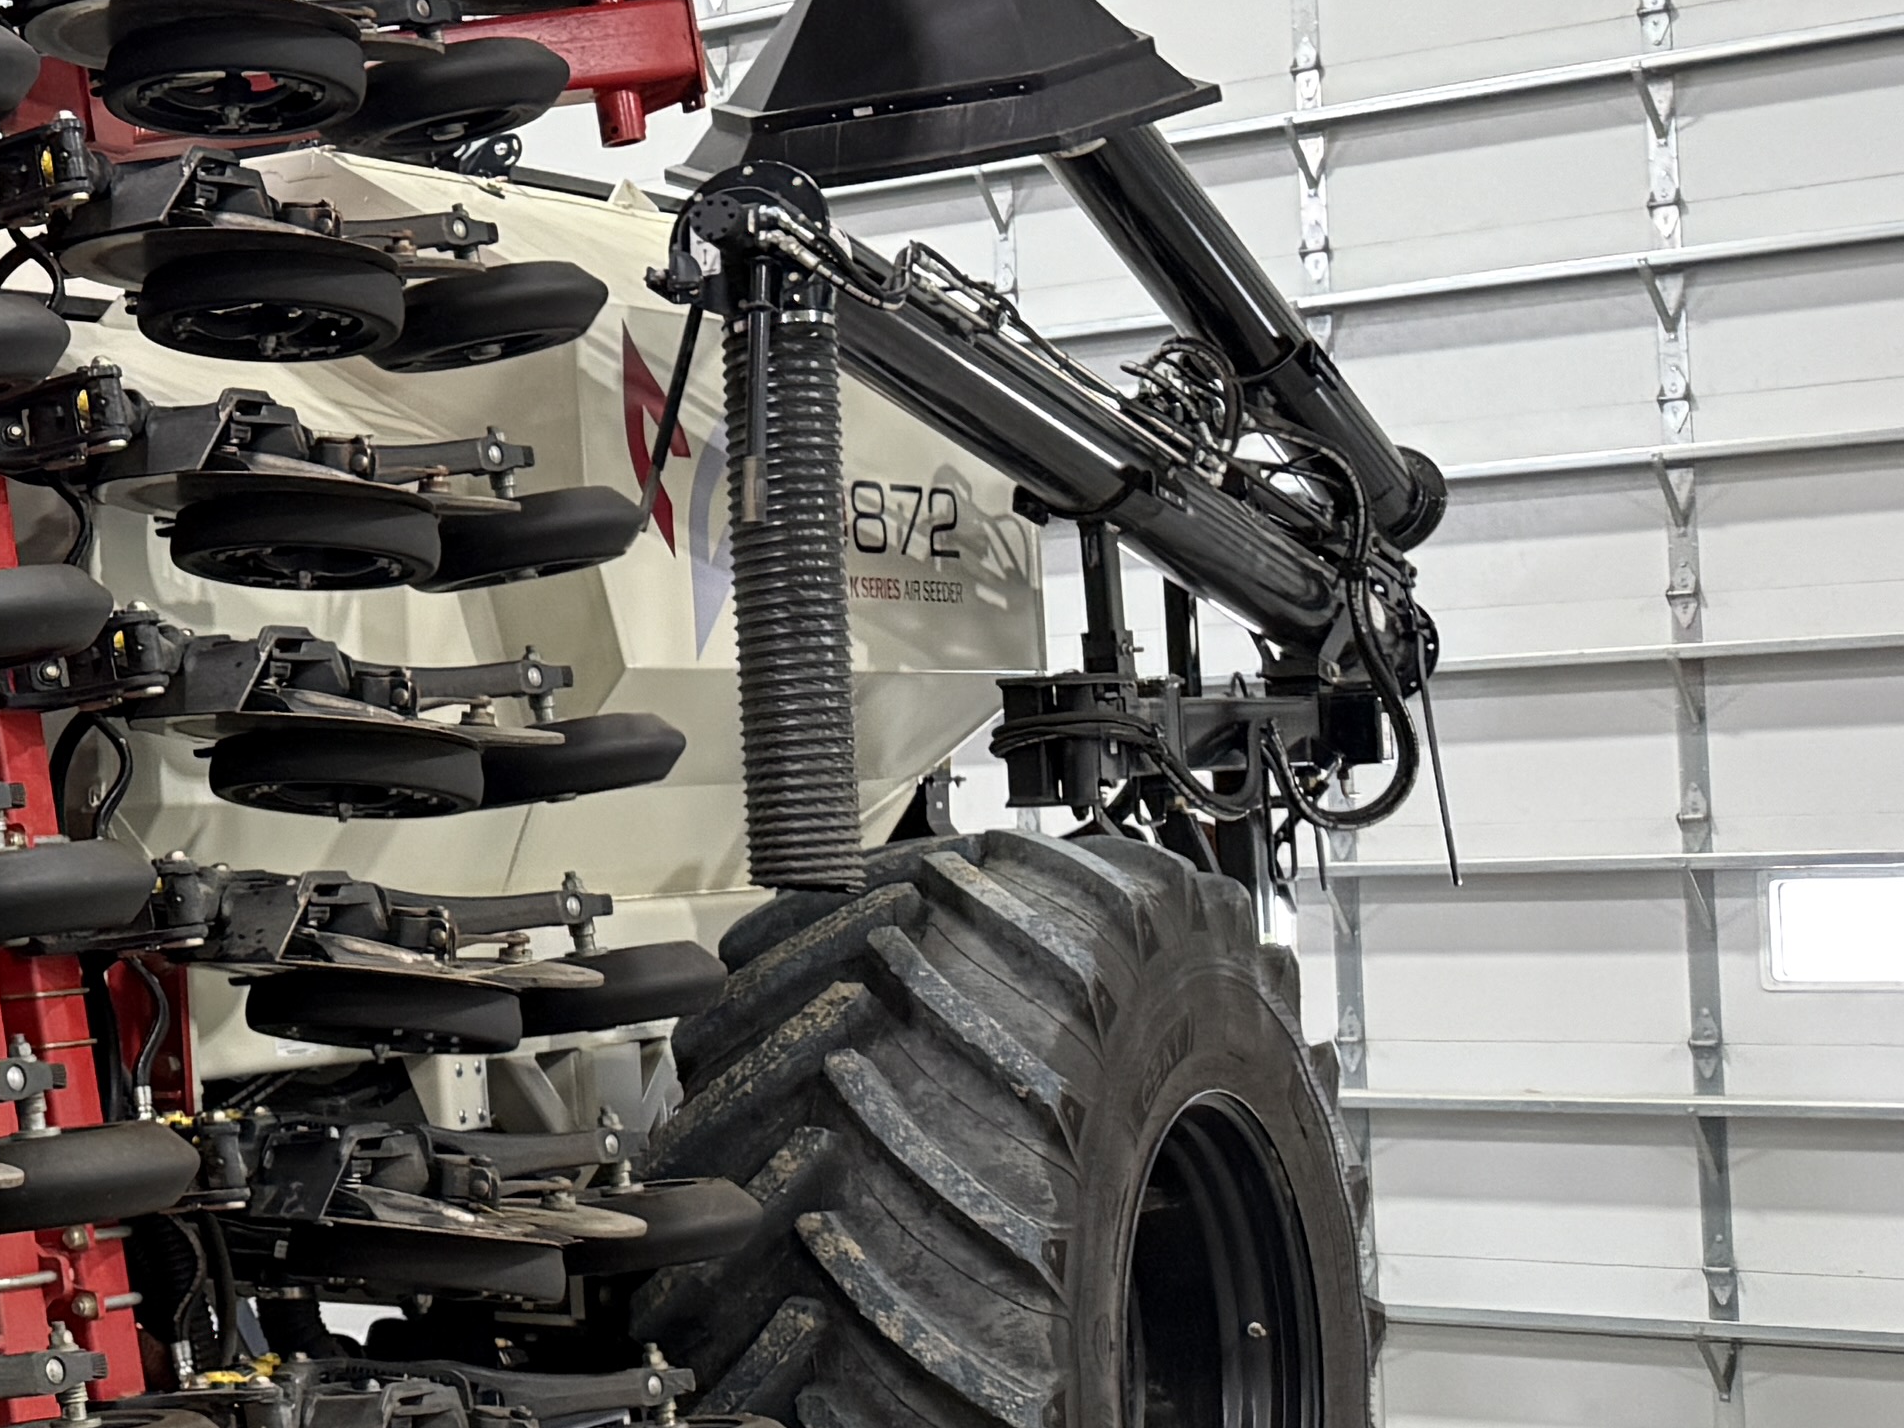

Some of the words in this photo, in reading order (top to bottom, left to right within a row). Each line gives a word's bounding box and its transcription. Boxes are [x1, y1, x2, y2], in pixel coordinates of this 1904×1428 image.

[851, 480, 960, 559] 872
[861, 578, 901, 600] SERIES
[903, 581, 921, 601] AIR
[923, 581, 963, 604] SEEDER
